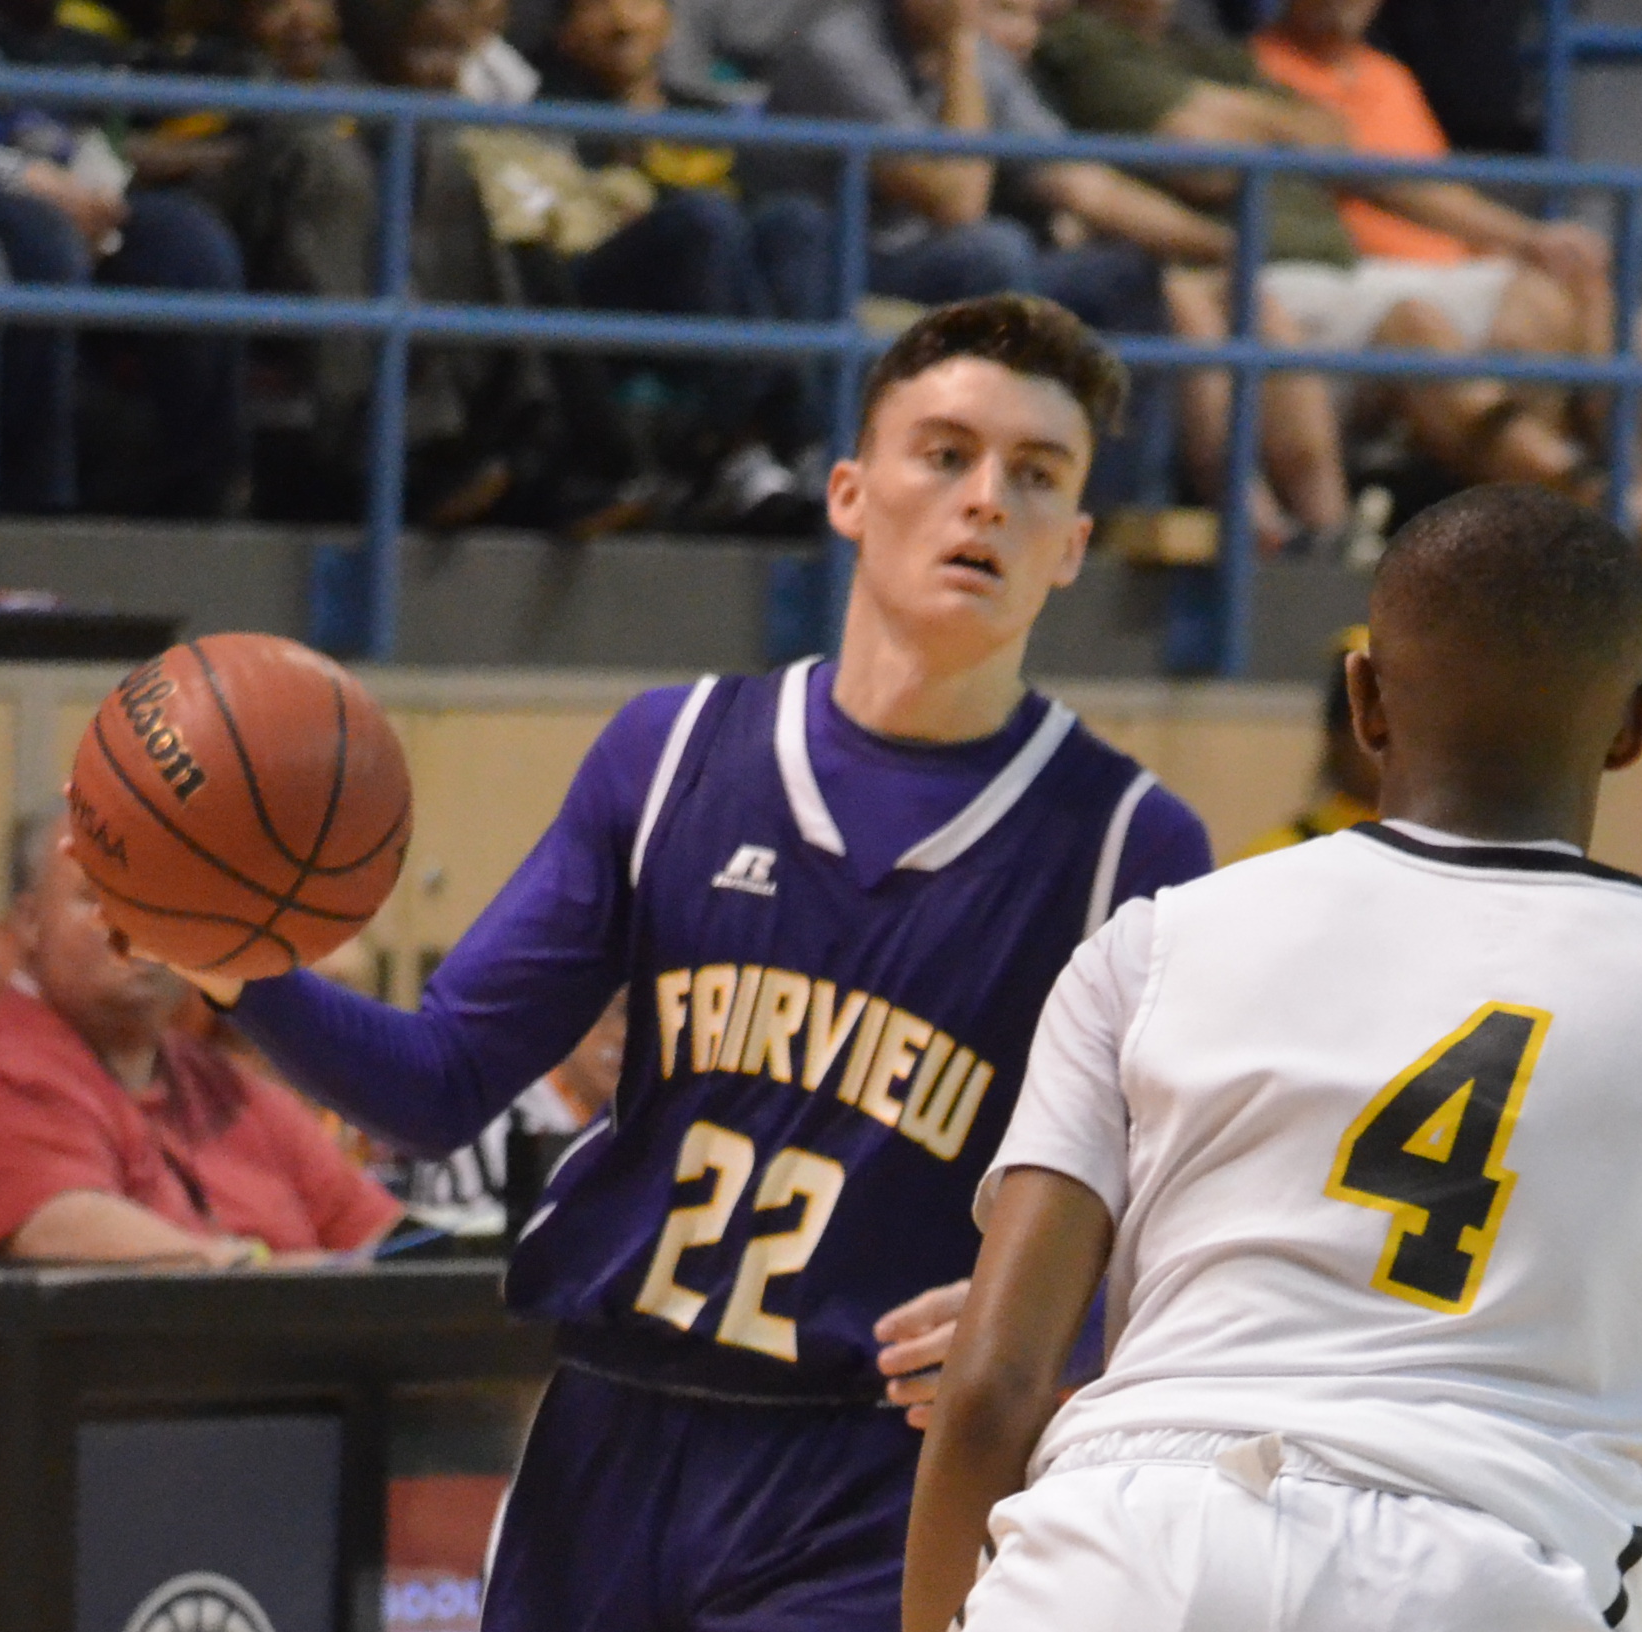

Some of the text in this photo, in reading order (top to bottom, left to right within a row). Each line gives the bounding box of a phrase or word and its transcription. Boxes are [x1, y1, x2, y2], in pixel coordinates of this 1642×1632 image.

[656, 962, 995, 1162] FAIRVIEW
[1323, 999, 1554, 1314] 4
[633, 1120, 845, 1363] 22
